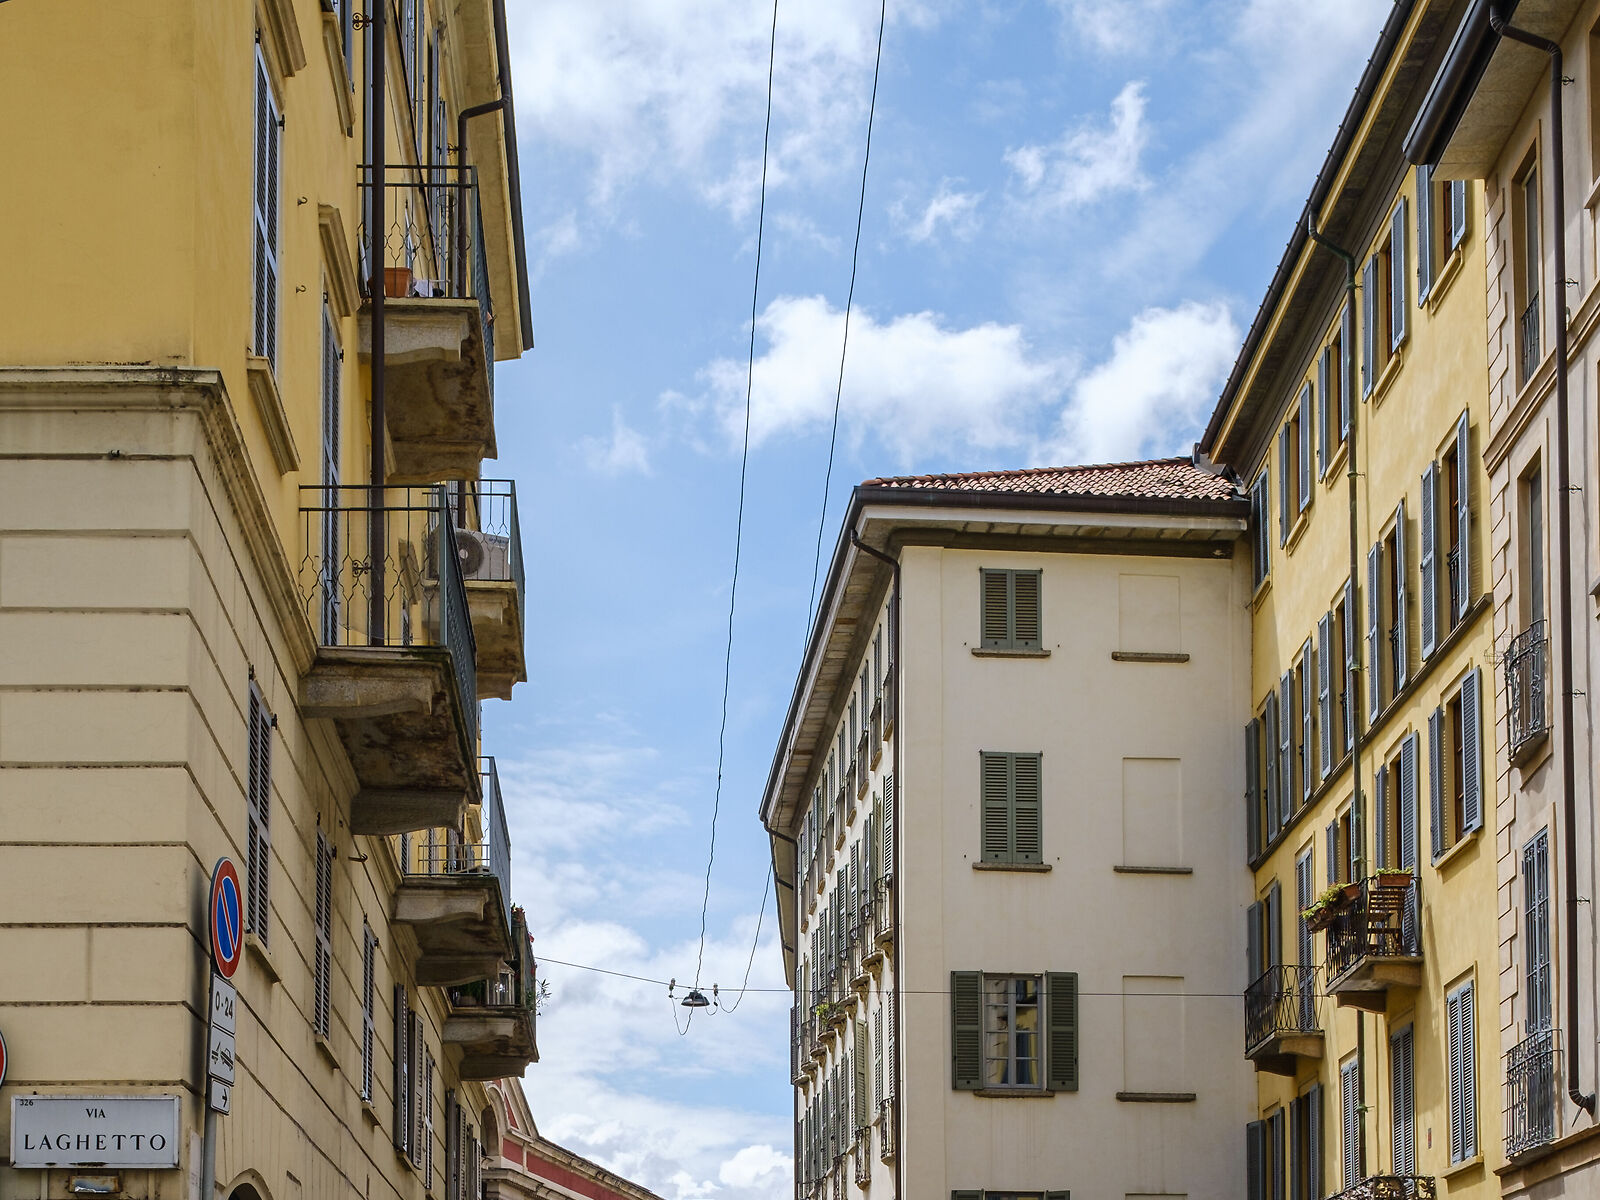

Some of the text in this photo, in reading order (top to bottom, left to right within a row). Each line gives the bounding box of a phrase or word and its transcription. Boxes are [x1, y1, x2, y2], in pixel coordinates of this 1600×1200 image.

[19, 1098, 34, 1106] 326
[86, 1108, 106, 1118] VIA
[24, 1134, 166, 1151] LAGHETTO
